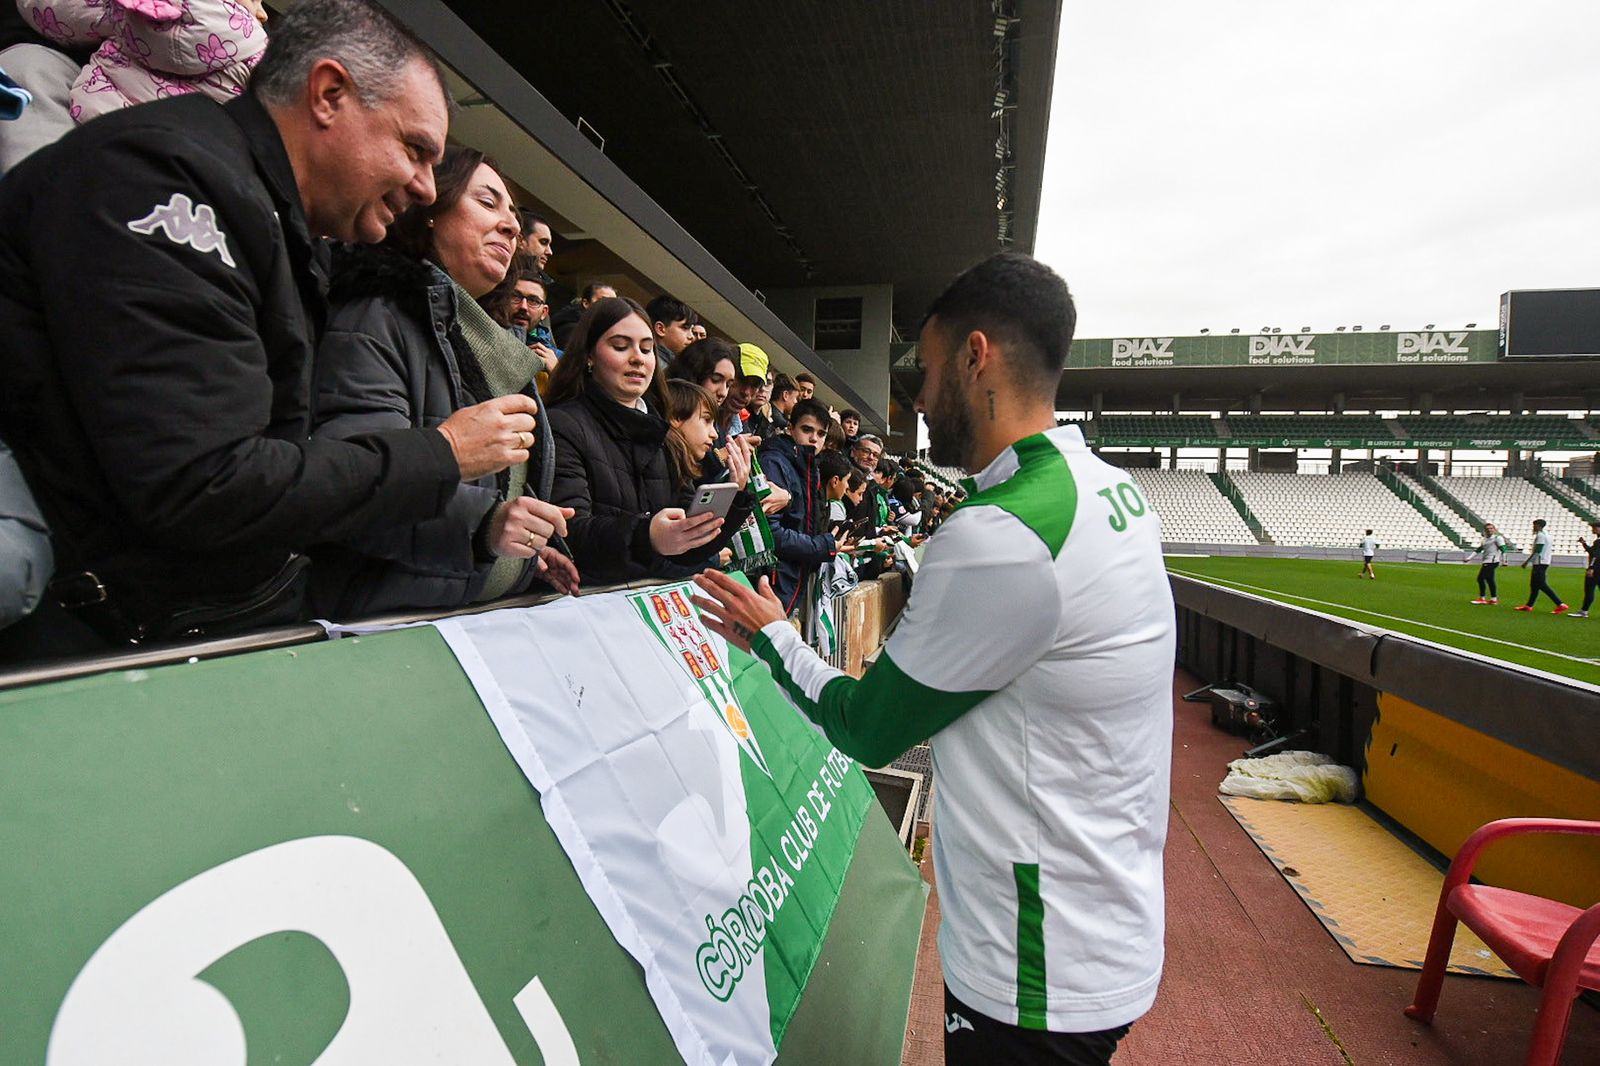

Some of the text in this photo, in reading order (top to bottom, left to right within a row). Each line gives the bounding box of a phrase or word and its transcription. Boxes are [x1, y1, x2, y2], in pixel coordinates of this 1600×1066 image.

[1112, 338, 1174, 358] DIAZ
[1249, 335, 1316, 356] DIAZ
[1397, 332, 1469, 353] DIAZ
[1112, 357, 1174, 366] food solutions
[1249, 354, 1315, 364] food solutions
[1397, 353, 1468, 362] food solutions
[1096, 480, 1152, 532] JO
[696, 856, 794, 1002] CÓRDOBA
[780, 805, 818, 871] CLUB
[806, 780, 831, 822] DE
